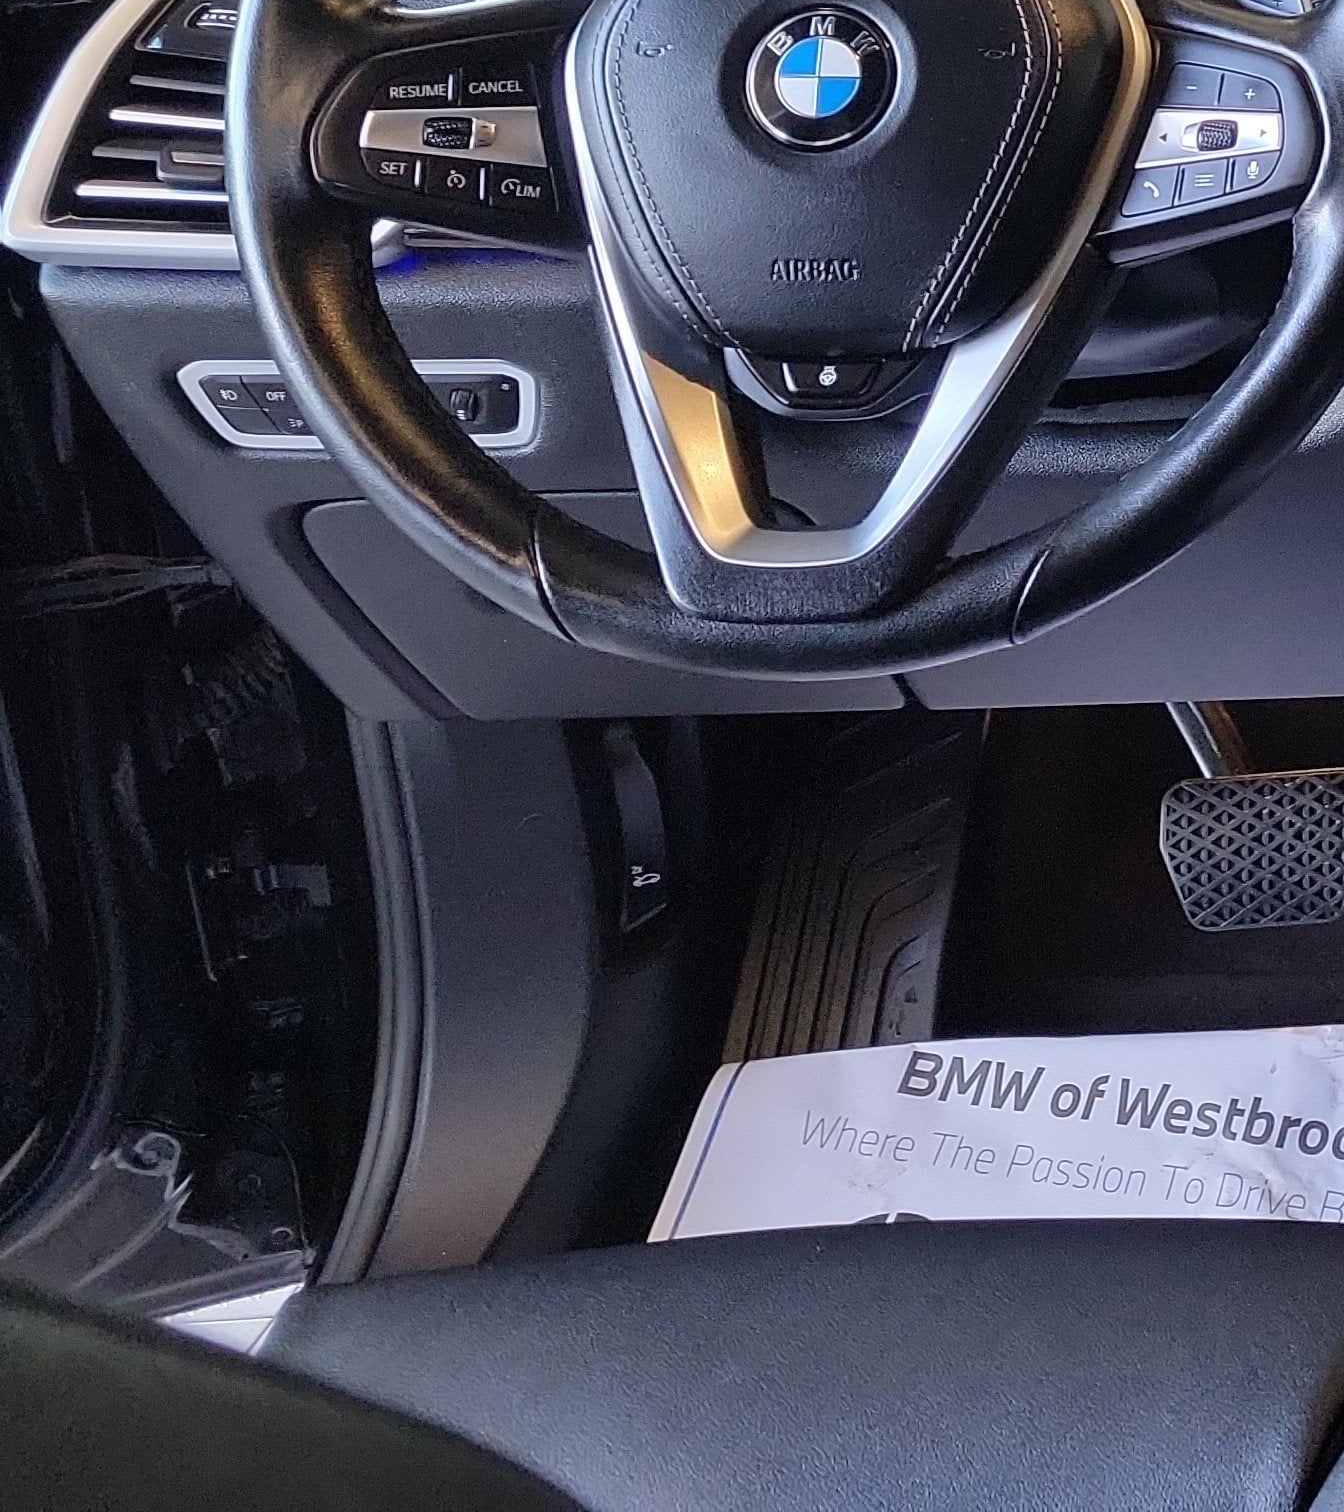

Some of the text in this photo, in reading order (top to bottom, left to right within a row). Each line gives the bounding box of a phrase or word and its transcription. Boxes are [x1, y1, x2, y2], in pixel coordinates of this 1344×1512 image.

[767, 16, 880, 56] BMW
[389, 84, 448, 99] RESUME
[468, 80, 523, 95] CANCEL
[379, 162, 407, 175] SET
[515, 185, 541, 199] LIM
[770, 257, 861, 283] AIRBAG
[265, 390, 286, 403] OFF
[897, 1050, 1046, 1112] BMW
[1050, 1075, 1111, 1120] of
[802, 1109, 916, 1162] Where
[931, 1131, 996, 1175] The
[1006, 1144, 1147, 1197] Passion
[1162, 1164, 1205, 1205] To
[1214, 1172, 1306, 1219] Drive
